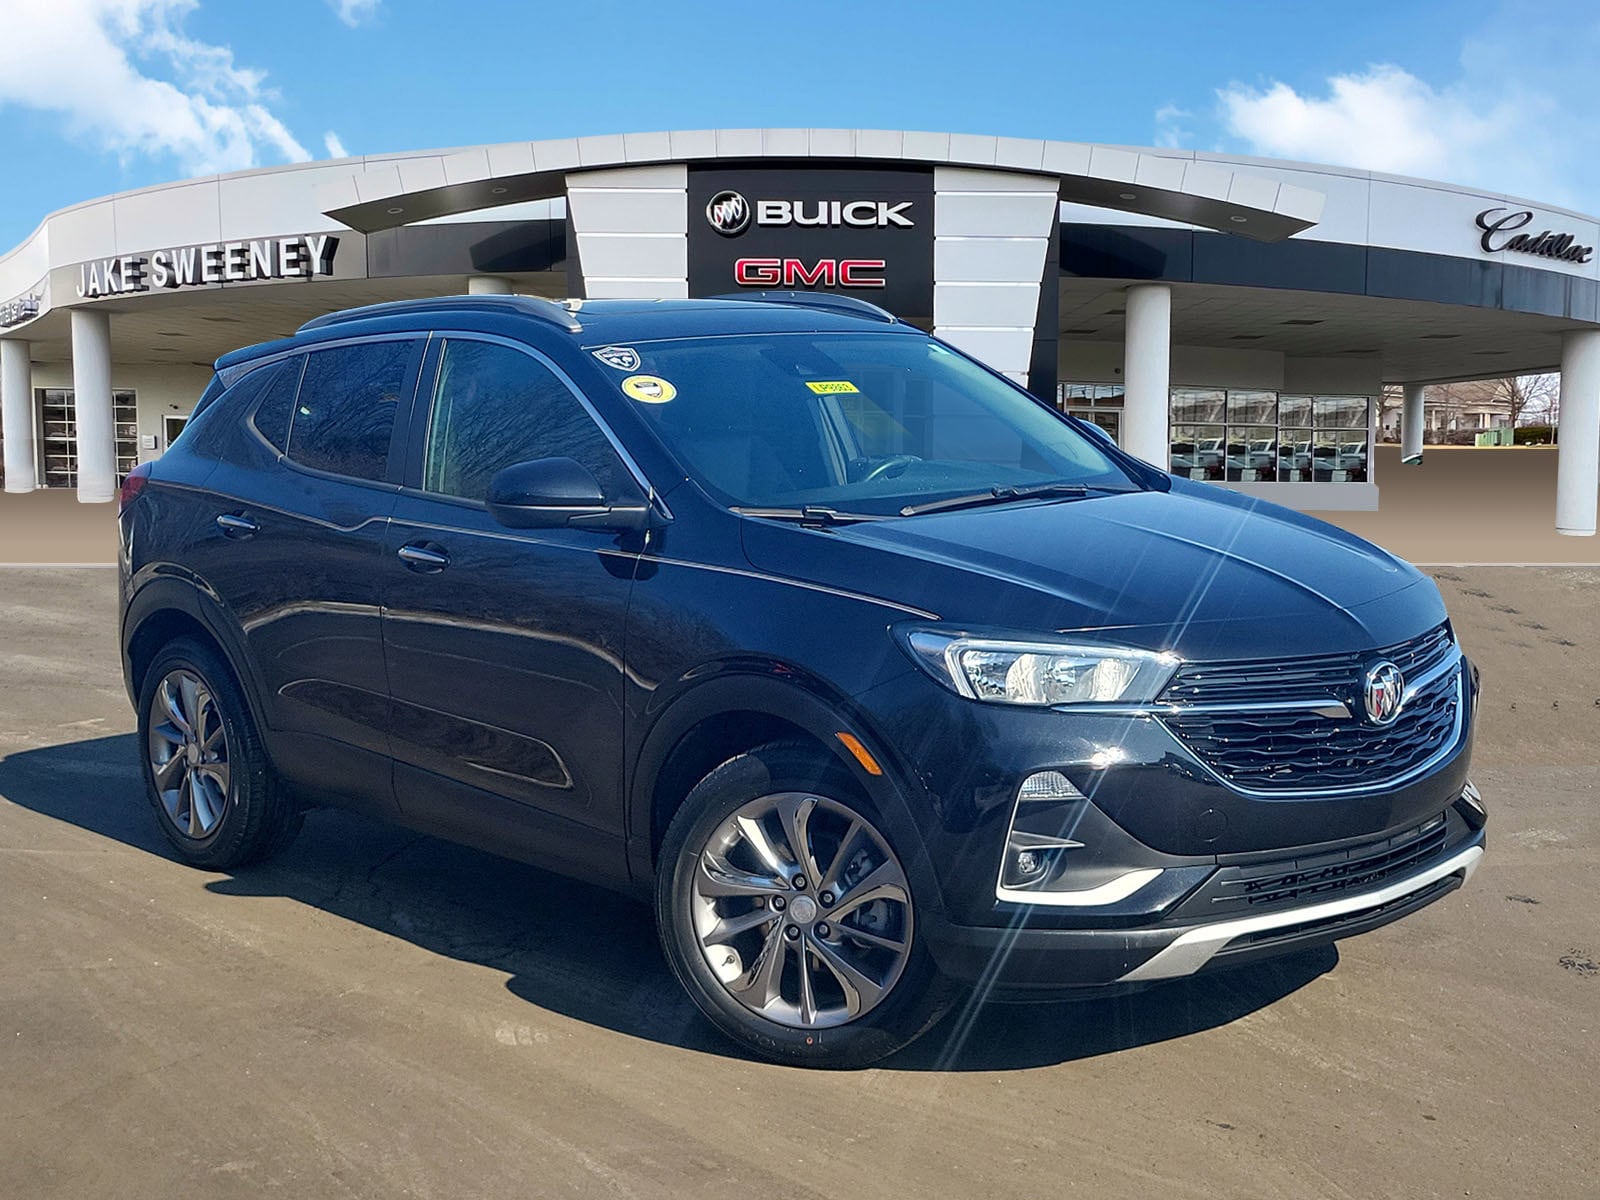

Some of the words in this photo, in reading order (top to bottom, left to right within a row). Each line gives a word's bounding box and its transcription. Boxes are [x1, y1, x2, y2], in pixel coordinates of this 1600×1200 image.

[757, 200, 914, 226] BUICK
[1475, 207, 1593, 264] Cadillac
[75, 256, 138, 298] JAKE
[150, 235, 332, 288] SWEENEY
[734, 258, 886, 286] GMC
